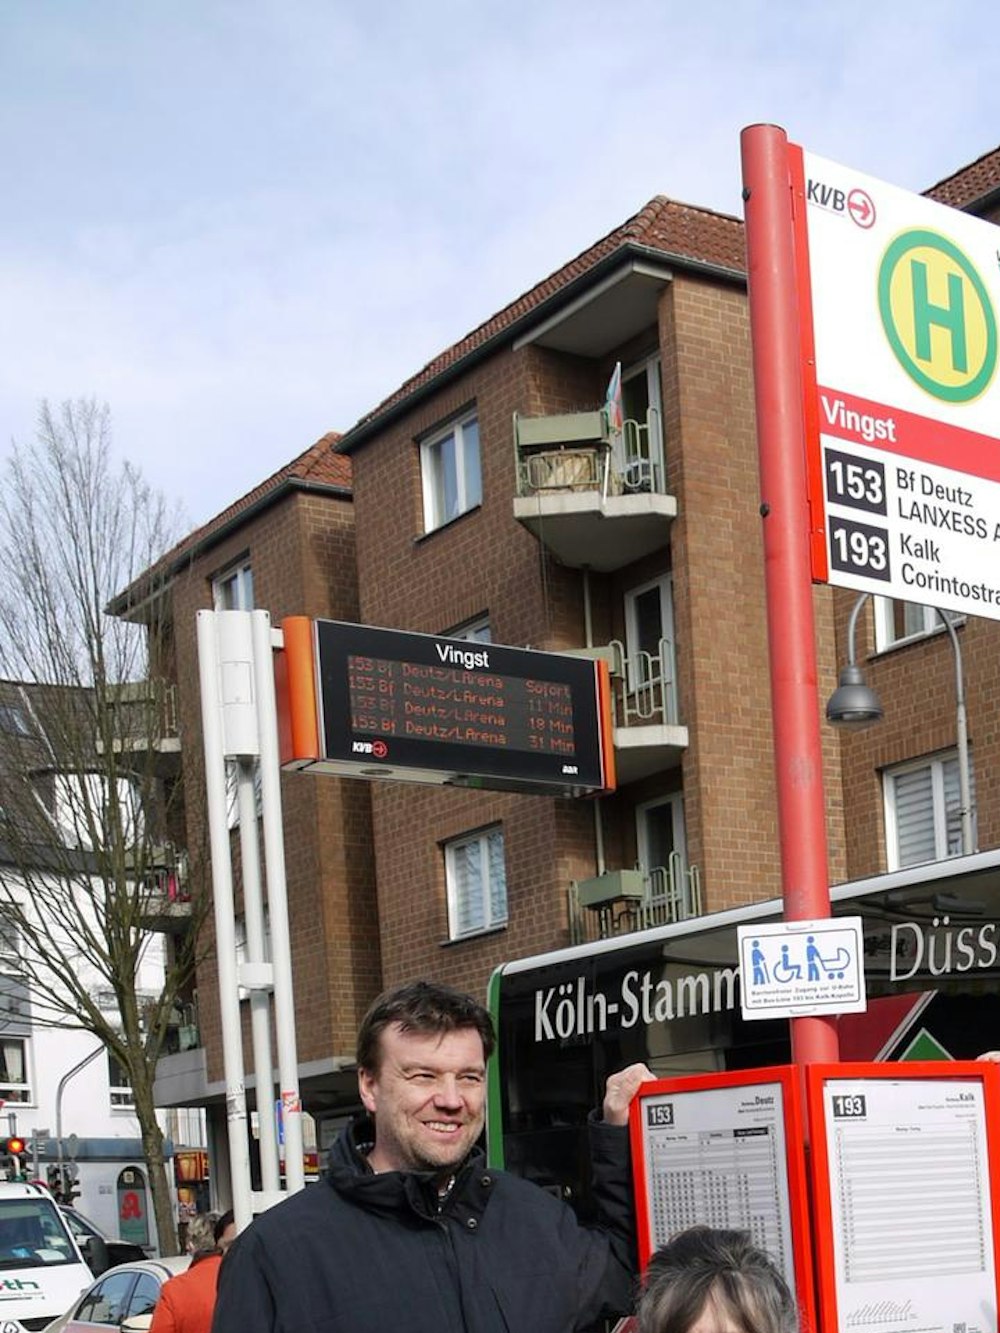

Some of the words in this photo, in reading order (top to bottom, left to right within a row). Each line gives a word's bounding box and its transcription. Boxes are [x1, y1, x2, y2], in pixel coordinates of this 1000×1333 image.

[807, 179, 846, 212] KVB
[910, 258, 968, 374] H
[821, 395, 897, 443] Vingst
[829, 460, 884, 505] 153
[896, 467, 916, 492] Bf
[921, 474, 974, 508] Deutz
[898, 497, 988, 540] LANXESS
[834, 528, 887, 571] 193
[900, 533, 941, 563] Kalk
[435, 643, 490, 669] Vingst
[352, 741, 374, 754] KVB
[650, 1105, 671, 1125] 153
[836, 1097, 863, 1116] 193
